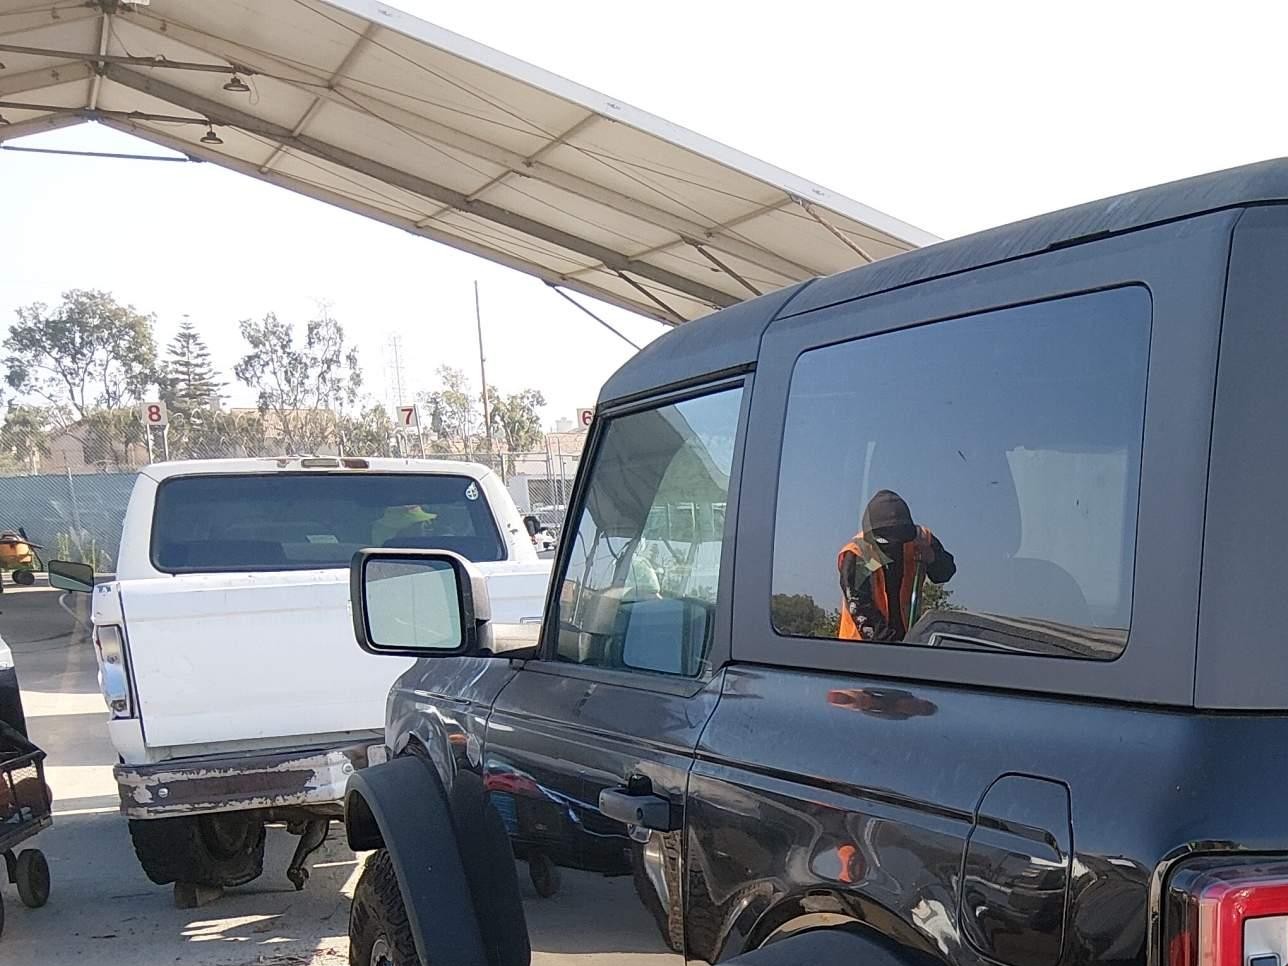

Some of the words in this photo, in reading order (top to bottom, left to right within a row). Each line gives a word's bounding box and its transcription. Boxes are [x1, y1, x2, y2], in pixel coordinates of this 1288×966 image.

[147, 404, 162, 422] 8
[400, 408, 414, 425] 7
[581, 410, 593, 426] 6
